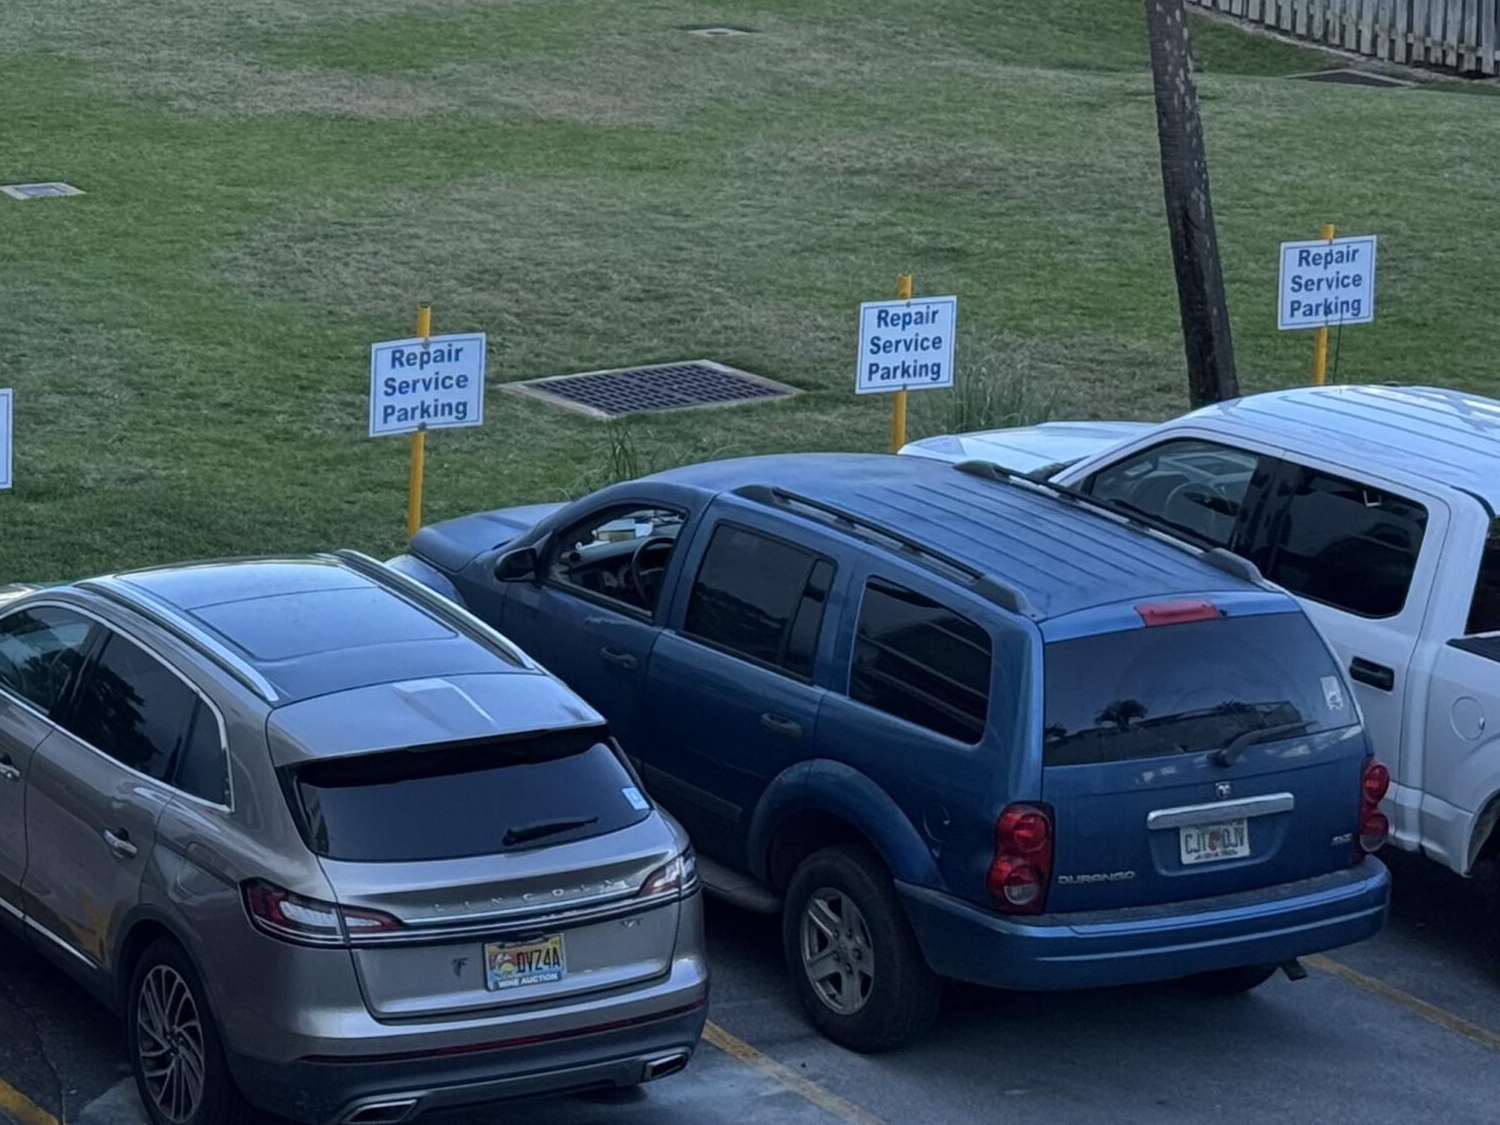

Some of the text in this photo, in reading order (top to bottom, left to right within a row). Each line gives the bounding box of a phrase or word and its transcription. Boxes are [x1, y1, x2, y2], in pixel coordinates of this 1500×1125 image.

[1298, 244, 1359, 270] Repair
[1290, 270, 1362, 293] Service
[877, 305, 939, 331] Repair
[1289, 296, 1361, 318] Parking
[869, 332, 942, 355] Service
[390, 343, 464, 370] Repair
[868, 359, 941, 382] Parking
[383, 372, 469, 397] Service
[382, 399, 468, 424] Parking
[1058, 871, 1136, 884] DURANGO
[434, 878, 618, 912] LINCOLN
[498, 973, 559, 988] WINE AUCTION
